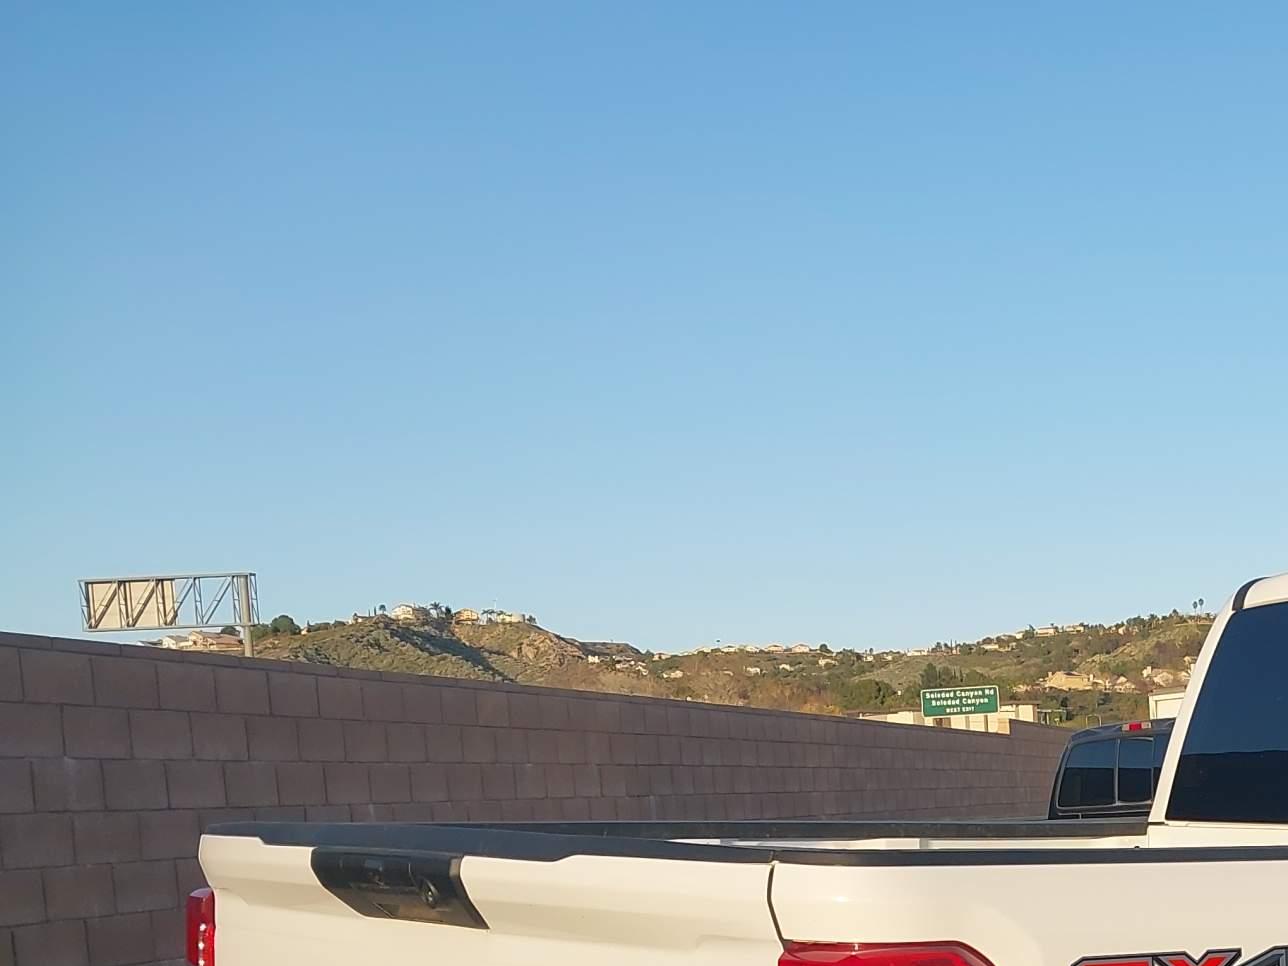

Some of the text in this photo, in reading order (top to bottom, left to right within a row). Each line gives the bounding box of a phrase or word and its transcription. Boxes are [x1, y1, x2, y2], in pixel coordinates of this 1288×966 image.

[925, 691, 954, 699] Soledad
[956, 690, 983, 698] Canyon
[931, 697, 989, 706] Soledad Canyon
